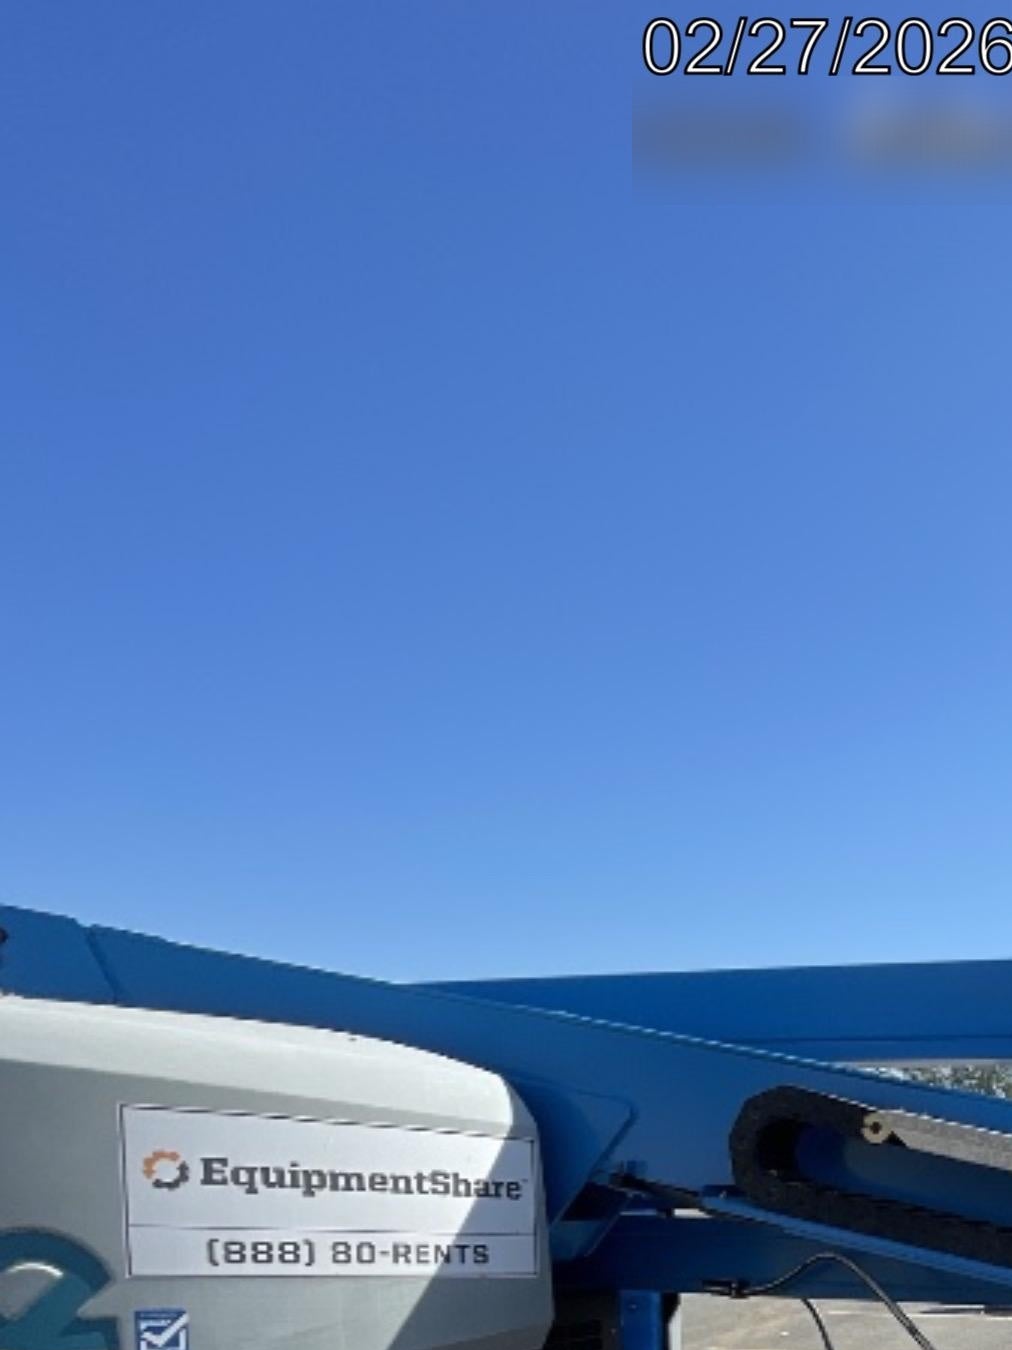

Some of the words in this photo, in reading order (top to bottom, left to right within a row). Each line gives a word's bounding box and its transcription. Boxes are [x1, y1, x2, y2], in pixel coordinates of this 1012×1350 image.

[200, 1156, 523, 1201] EquipmentShare
[206, 1238, 316, 1267] (888)
[330, 1241, 491, 1265] 80-RENTS
